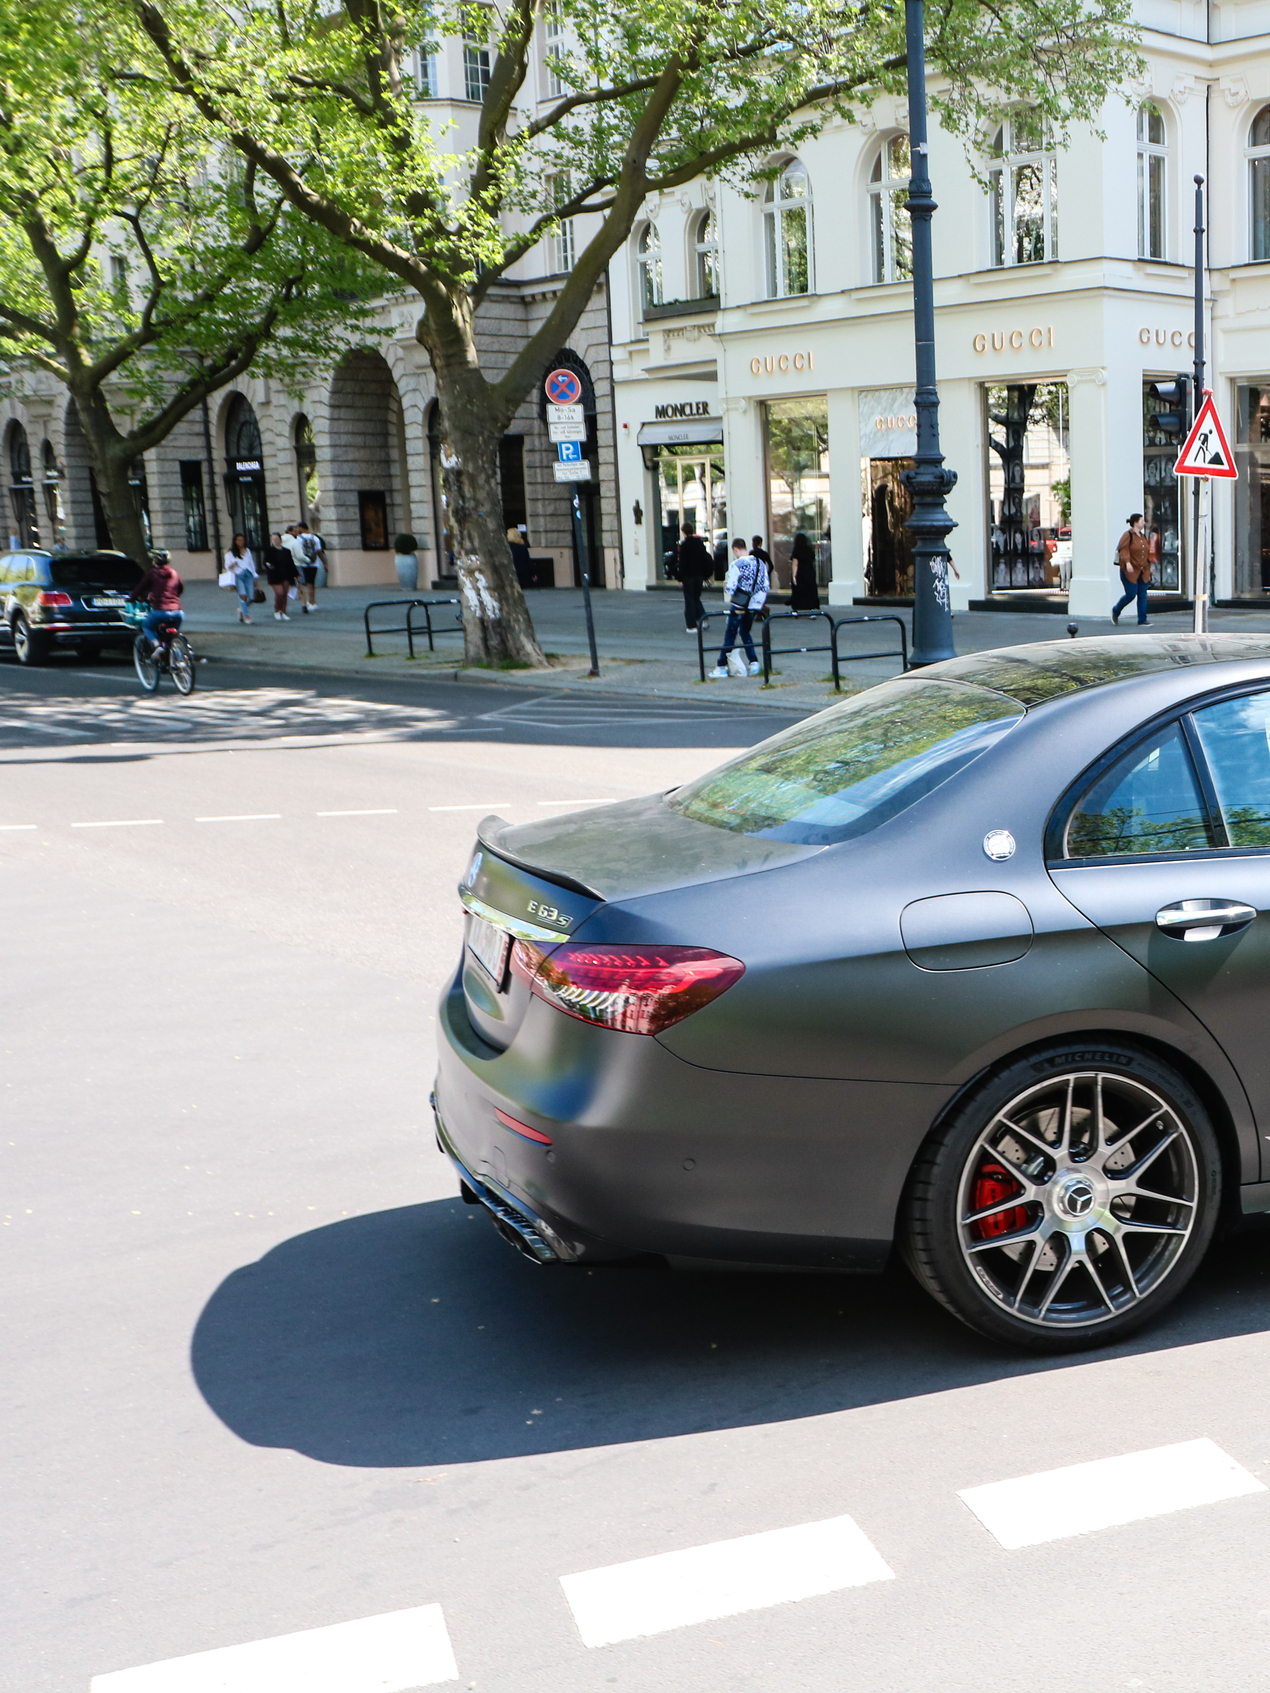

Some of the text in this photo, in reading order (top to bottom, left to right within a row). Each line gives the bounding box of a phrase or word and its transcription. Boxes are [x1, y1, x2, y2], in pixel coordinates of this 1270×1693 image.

[972, 326, 1055, 353] GUCCI
[750, 350, 814, 376] GUCCI
[655, 401, 710, 418] MONCLER
[875, 414, 917, 430] GUCC
[527, 899, 539, 913] E
[538, 904, 559, 920] 63
[1053, 1051, 1130, 1065] MICHELIN
